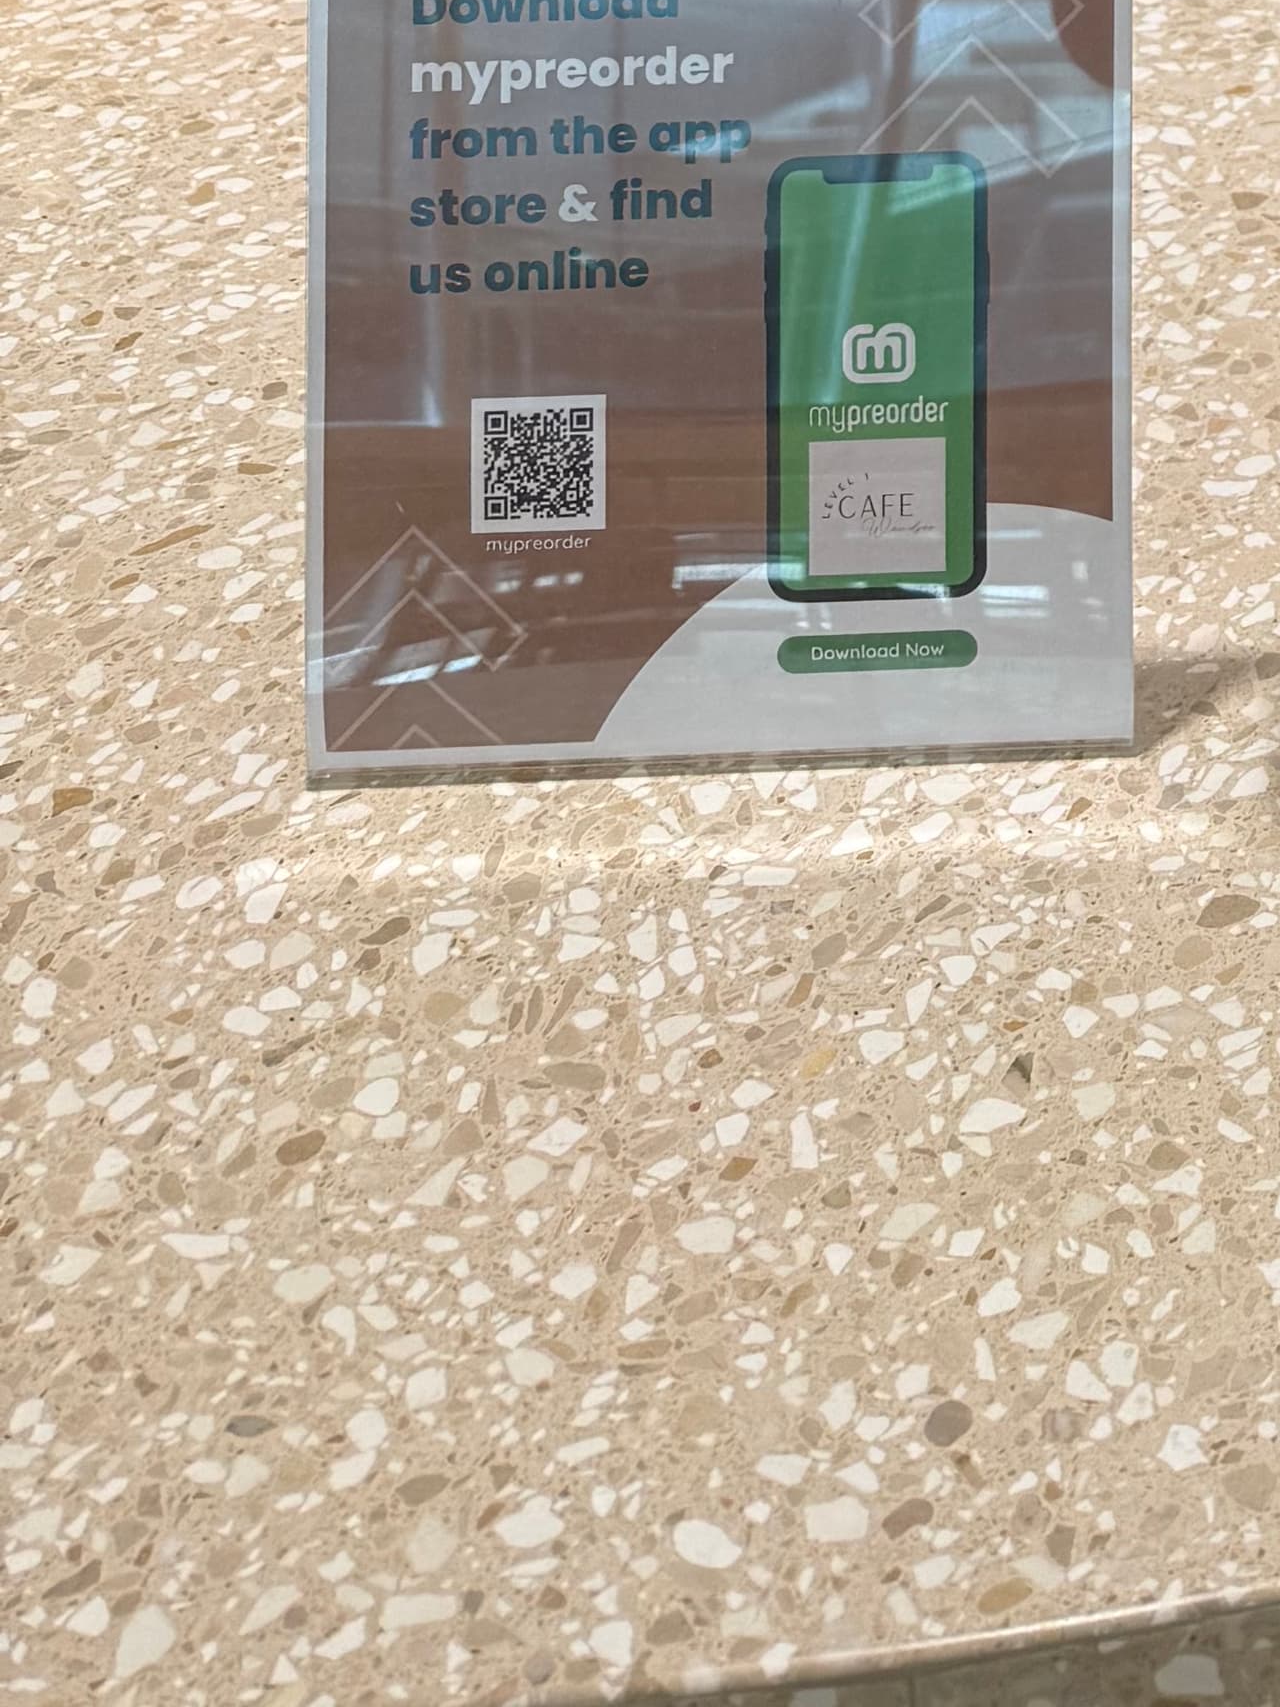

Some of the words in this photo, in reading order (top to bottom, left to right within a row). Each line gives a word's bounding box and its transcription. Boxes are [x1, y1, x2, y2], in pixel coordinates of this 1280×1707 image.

[410, 46, 736, 105] mypreorder
[409, 117, 538, 160] from
[550, 115, 638, 156] the
[648, 116, 753, 165] app
[409, 188, 547, 228] store
[557, 183, 600, 224] &
[610, 179, 713, 221] find
[409, 260, 471, 295] us
[484, 247, 650, 293] online
[808, 395, 949, 433] mypreorder
[838, 492, 915, 519] CAFE
[485, 535, 593, 555] mypreorder
[810, 643, 900, 662] Download
[905, 642, 946, 658] Now
